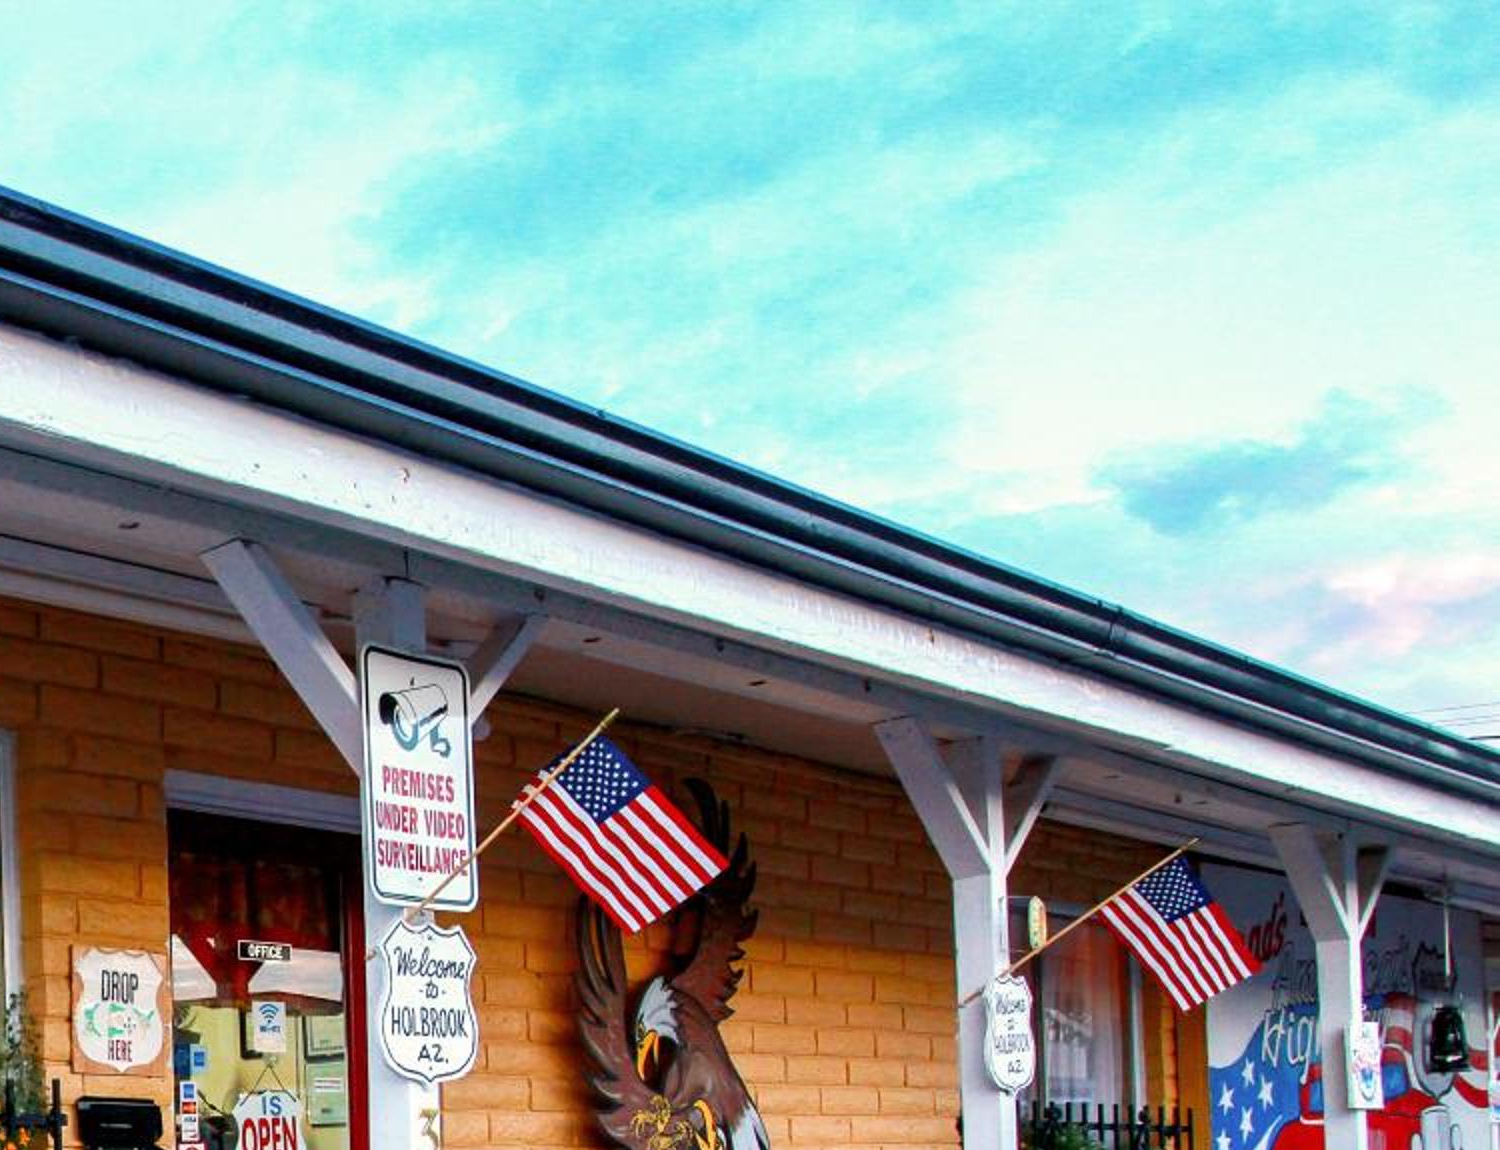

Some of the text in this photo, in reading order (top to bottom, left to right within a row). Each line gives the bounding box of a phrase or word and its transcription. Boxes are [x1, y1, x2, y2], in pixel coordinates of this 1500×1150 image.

[382, 765, 455, 803] PREMISES
[376, 801, 465, 840] UNDER VIDEO
[377, 839, 469, 877] SURVEILLANCE
[248, 944, 283, 958] OFFICE
[393, 946, 466, 980] Welcome
[101, 969, 138, 1005] DROP
[391, 1006, 468, 1039] HOLBROOK
[108, 1039, 133, 1063] HERE
[261, 1095, 283, 1116] IS
